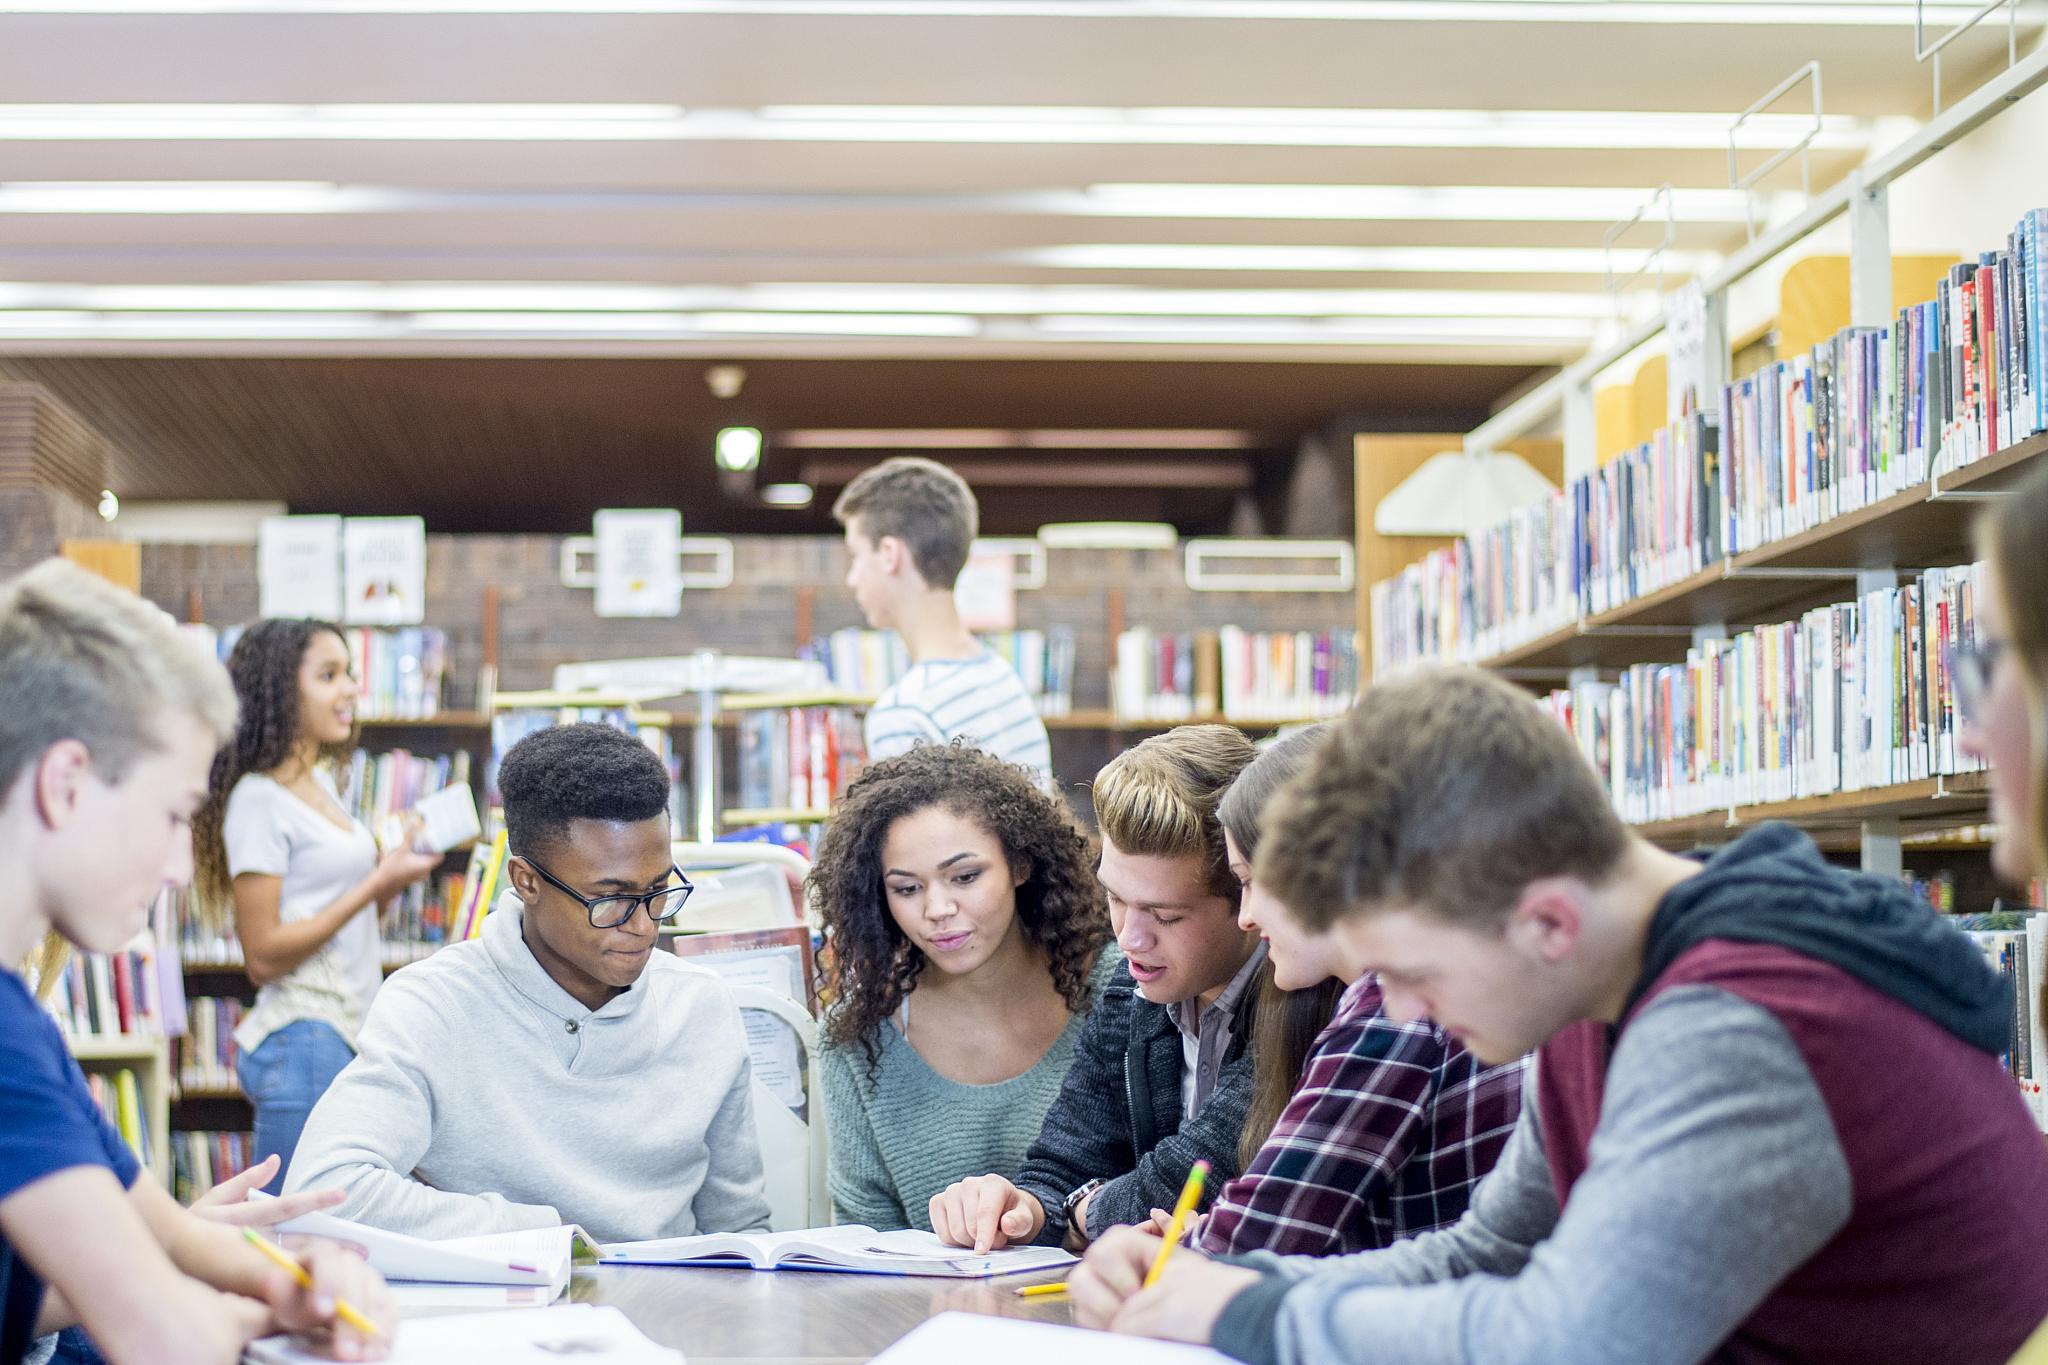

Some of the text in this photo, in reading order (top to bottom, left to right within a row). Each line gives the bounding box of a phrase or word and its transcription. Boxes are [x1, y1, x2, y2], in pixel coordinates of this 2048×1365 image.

[1962, 291, 1971, 321] DEAR
[1963, 323, 1971, 349] LIFE
[1964, 359, 1972, 392] ALICE
[1832, 611, 1841, 670] POLAND
[704, 946, 746, 956] BARBARA
[749, 942, 784, 951] TAYLOR
